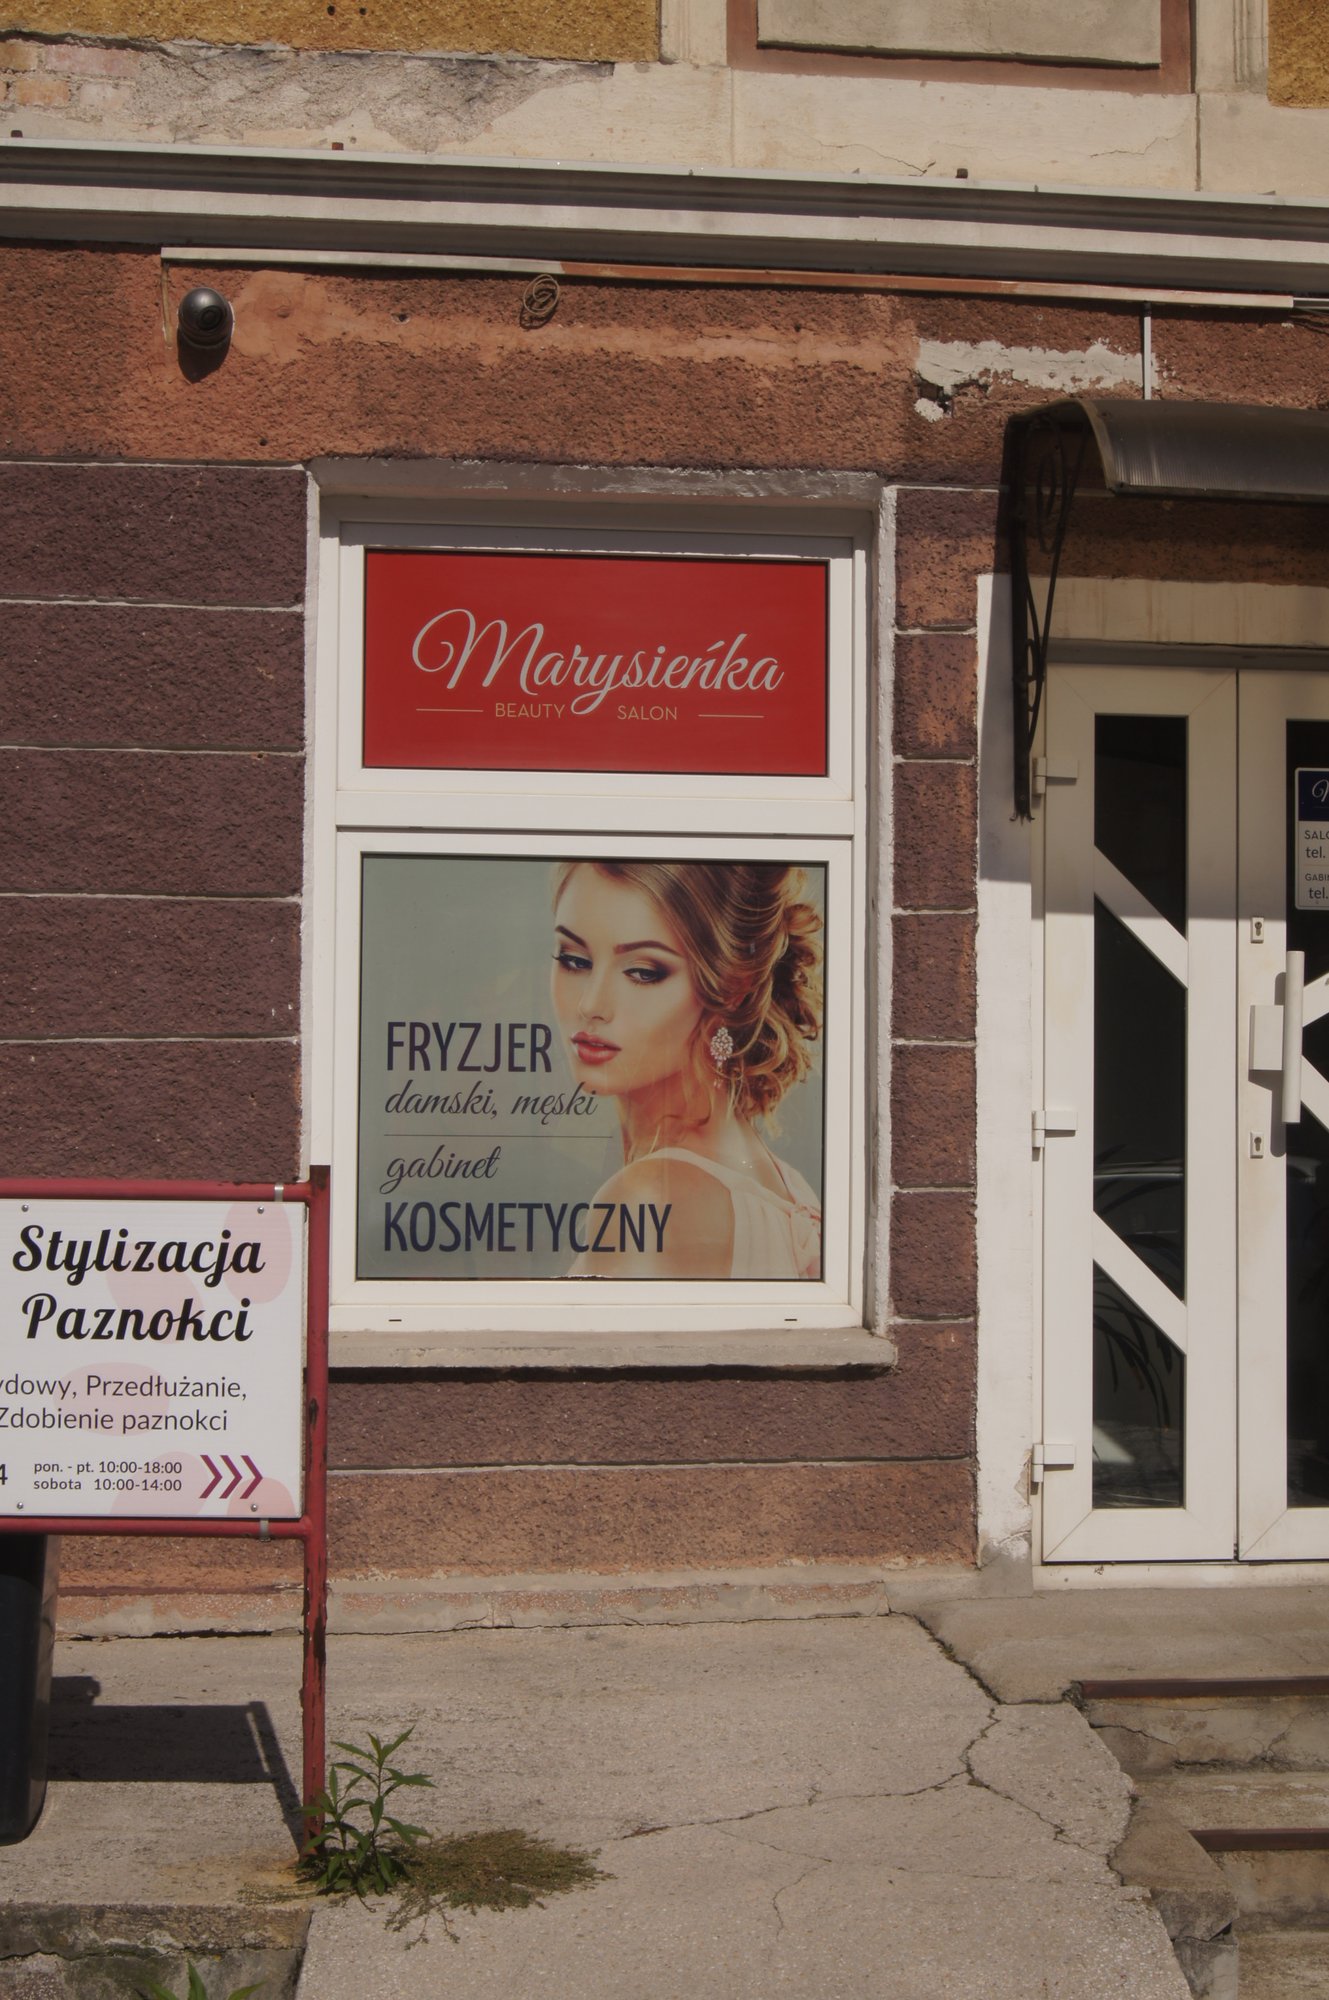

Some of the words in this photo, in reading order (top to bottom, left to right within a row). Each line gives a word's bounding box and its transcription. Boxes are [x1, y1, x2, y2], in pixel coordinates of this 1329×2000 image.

[412, 608, 784, 715] Marysieńka
[494, 703, 565, 719] BEAUTY
[616, 705, 678, 721] SALON
[1305, 846, 1326, 859] tel.
[1309, 887, 1329, 900] tel.
[387, 1022, 552, 1072] FRYZJER
[384, 1079, 498, 1120] damski,
[510, 1081, 598, 1125] męski
[379, 1144, 501, 1195] gabinet
[384, 1202, 672, 1253] KOSMETYCZNY
[12, 1224, 266, 1287] Stylizacja
[22, 1293, 254, 1342] Paznokci
[86, 1375, 247, 1401] Przedłużanie,
[0, 1407, 114, 1430] Zdobienie
[122, 1409, 228, 1434] paznokci
[33, 1478, 82, 1490] sobota
[94, 1479, 183, 1491] 10:00-14:00
[34, 1462, 63, 1475] pon.
[76, 1463, 95, 1475] pt.
[98, 1461, 183, 1475] 10:00-18:00
